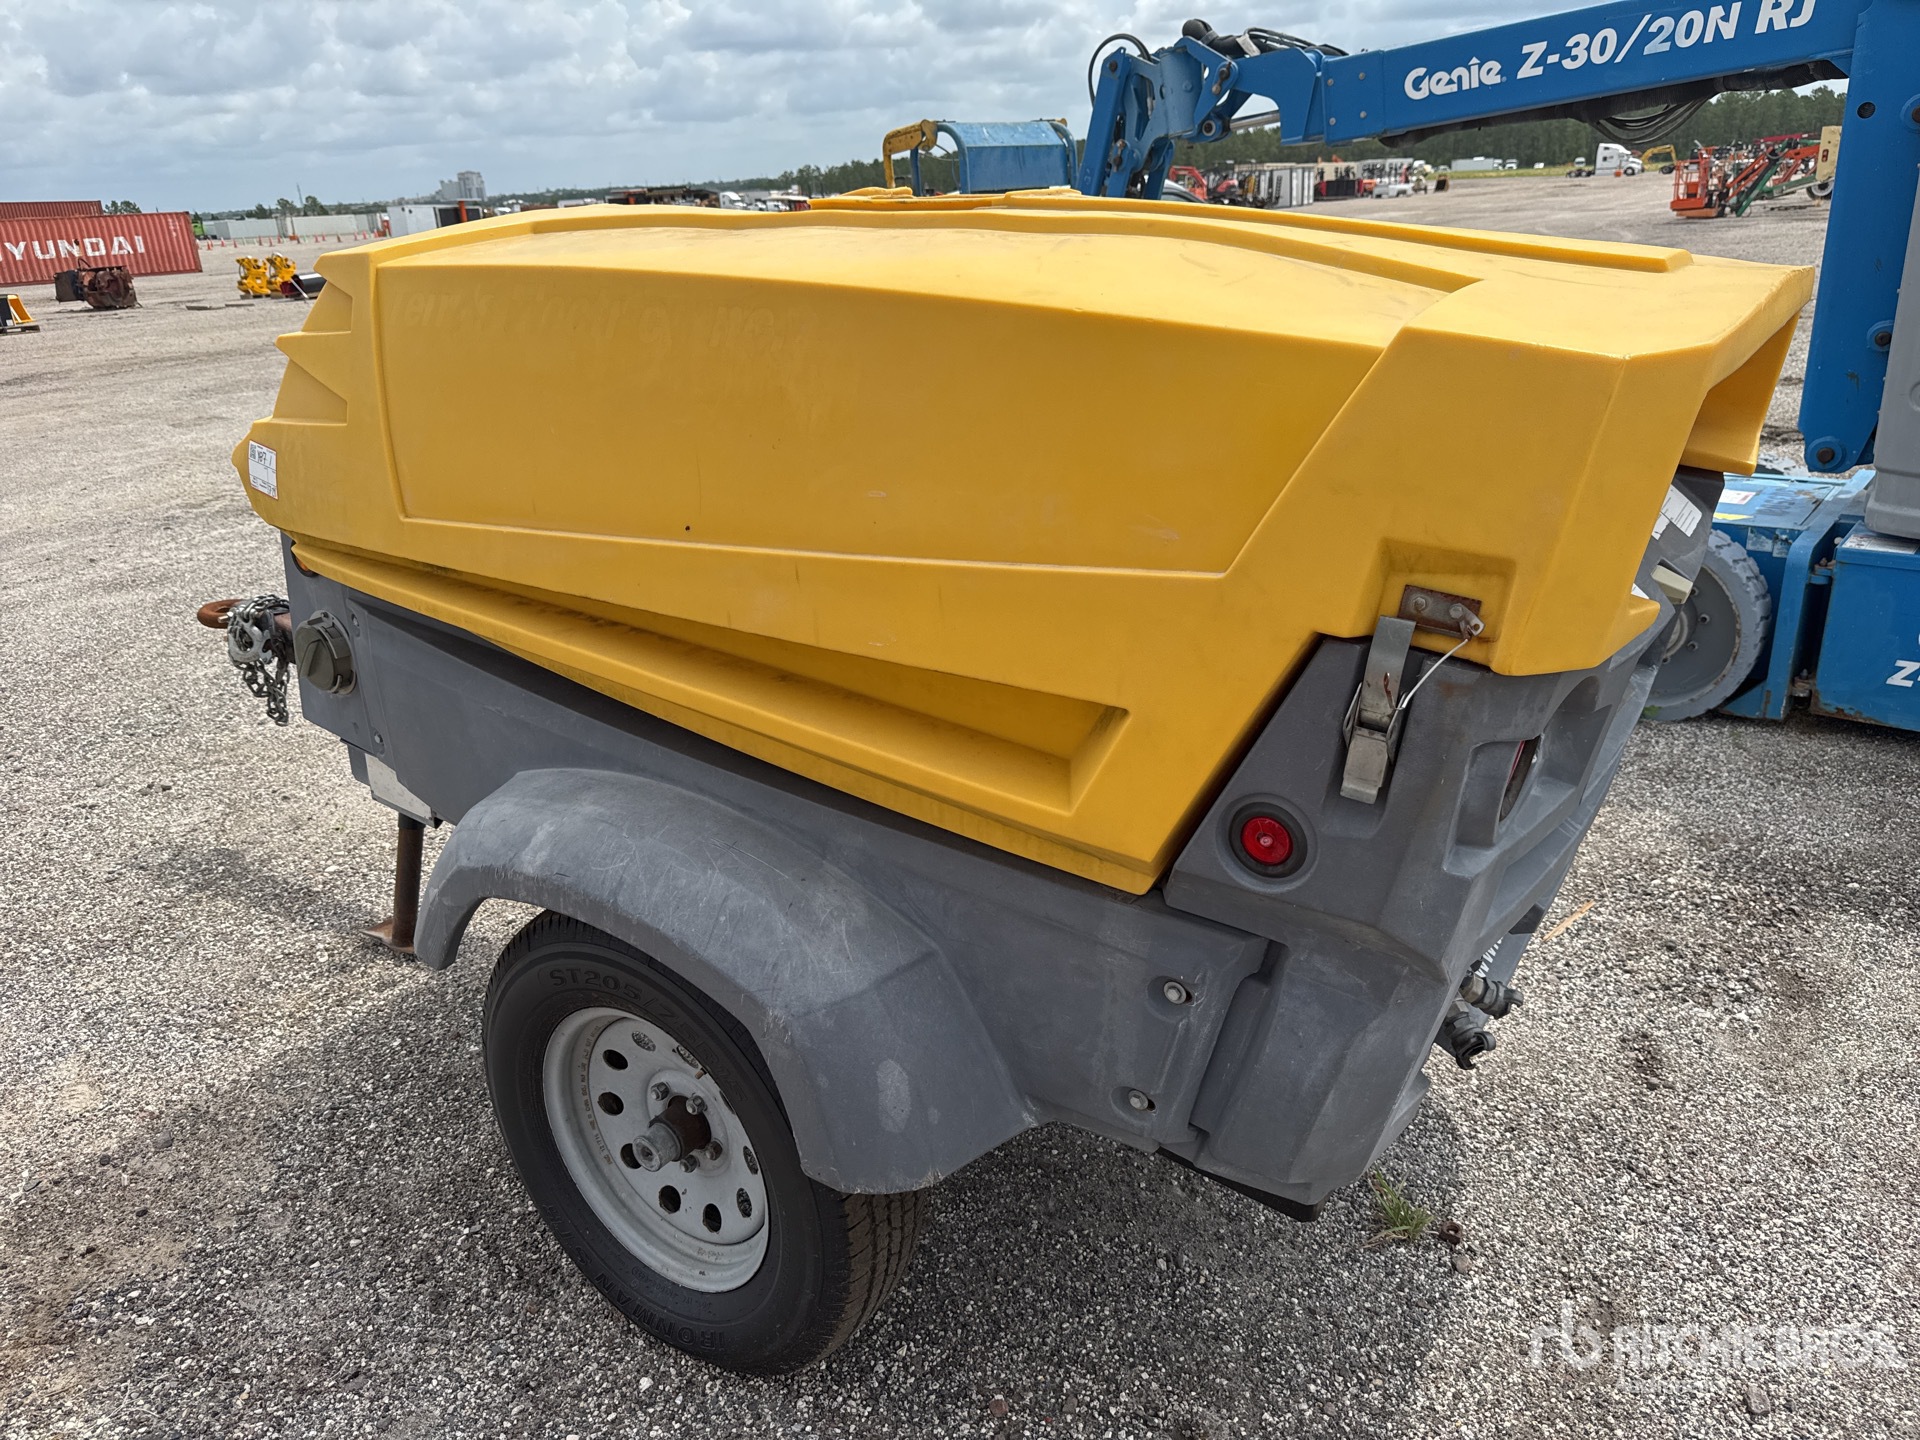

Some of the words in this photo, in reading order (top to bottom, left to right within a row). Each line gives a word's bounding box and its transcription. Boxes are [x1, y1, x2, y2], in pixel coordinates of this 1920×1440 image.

[1517, 1, 1742, 80] Z-30/20N
[1755, 0, 1816, 35] RJ
[0, 236, 146, 260] YUNDAI
[1885, 659, 1920, 688] Z
[595, 1272, 726, 1350] IRONMAN
